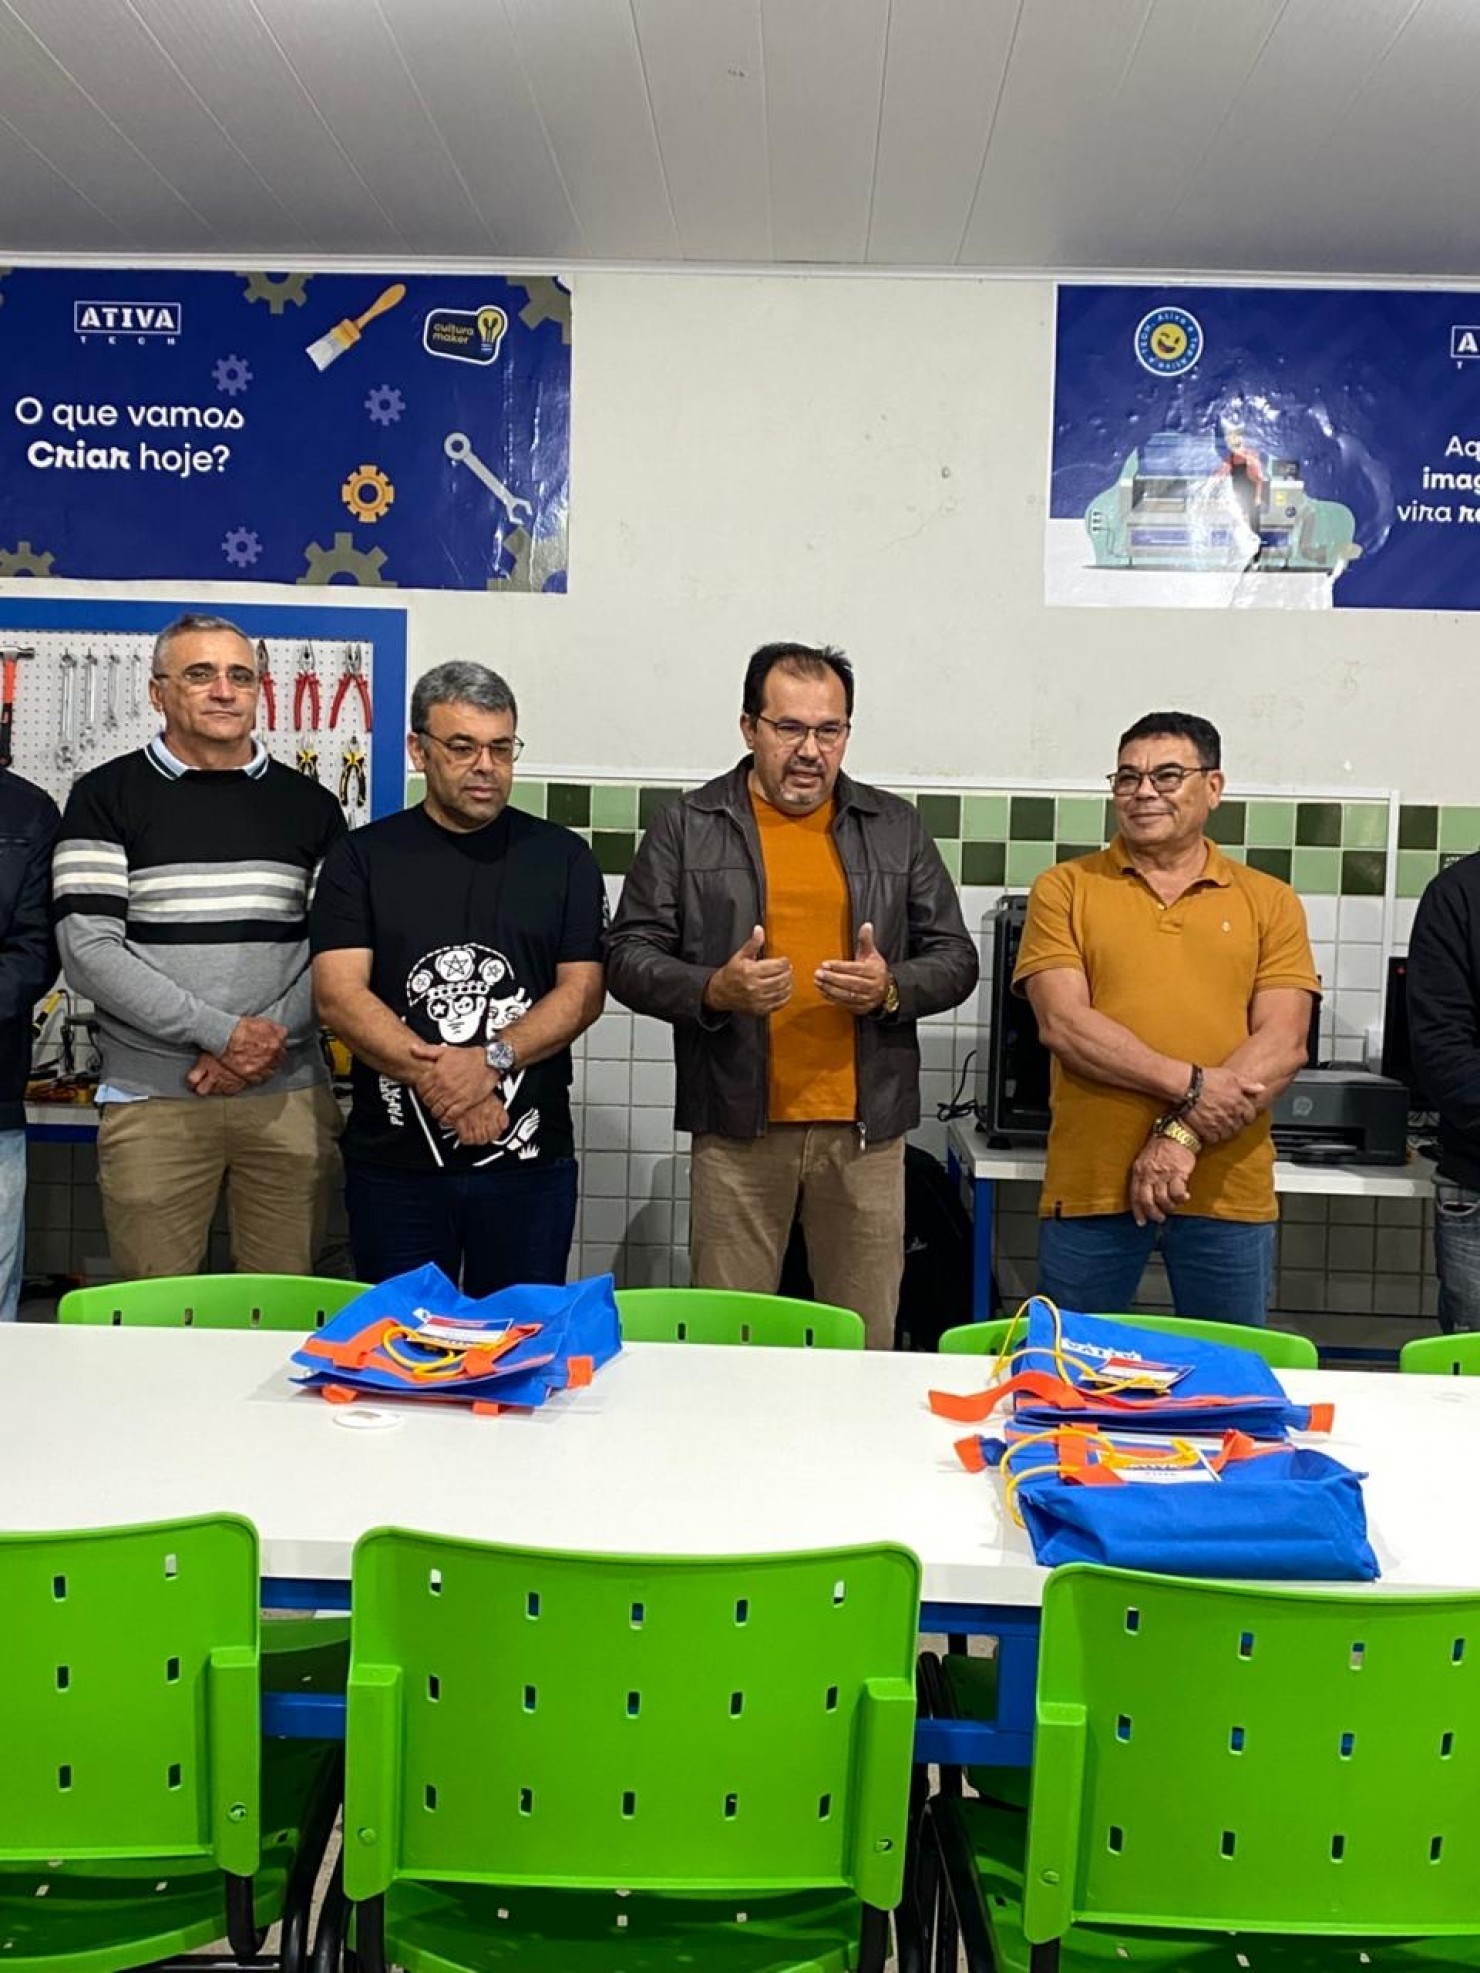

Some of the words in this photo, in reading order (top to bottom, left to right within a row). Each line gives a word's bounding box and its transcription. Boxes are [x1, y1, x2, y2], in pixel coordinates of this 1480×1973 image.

[81, 307, 174, 328] ATIVA
[80, 336, 175, 345] TECH
[15, 397, 43, 424] O
[52, 404, 118, 432] que
[127, 406, 245, 429] vamos
[27, 439, 130, 469] Criar
[140, 442, 230, 478] hoje?
[1397, 500, 1452, 522] vira
